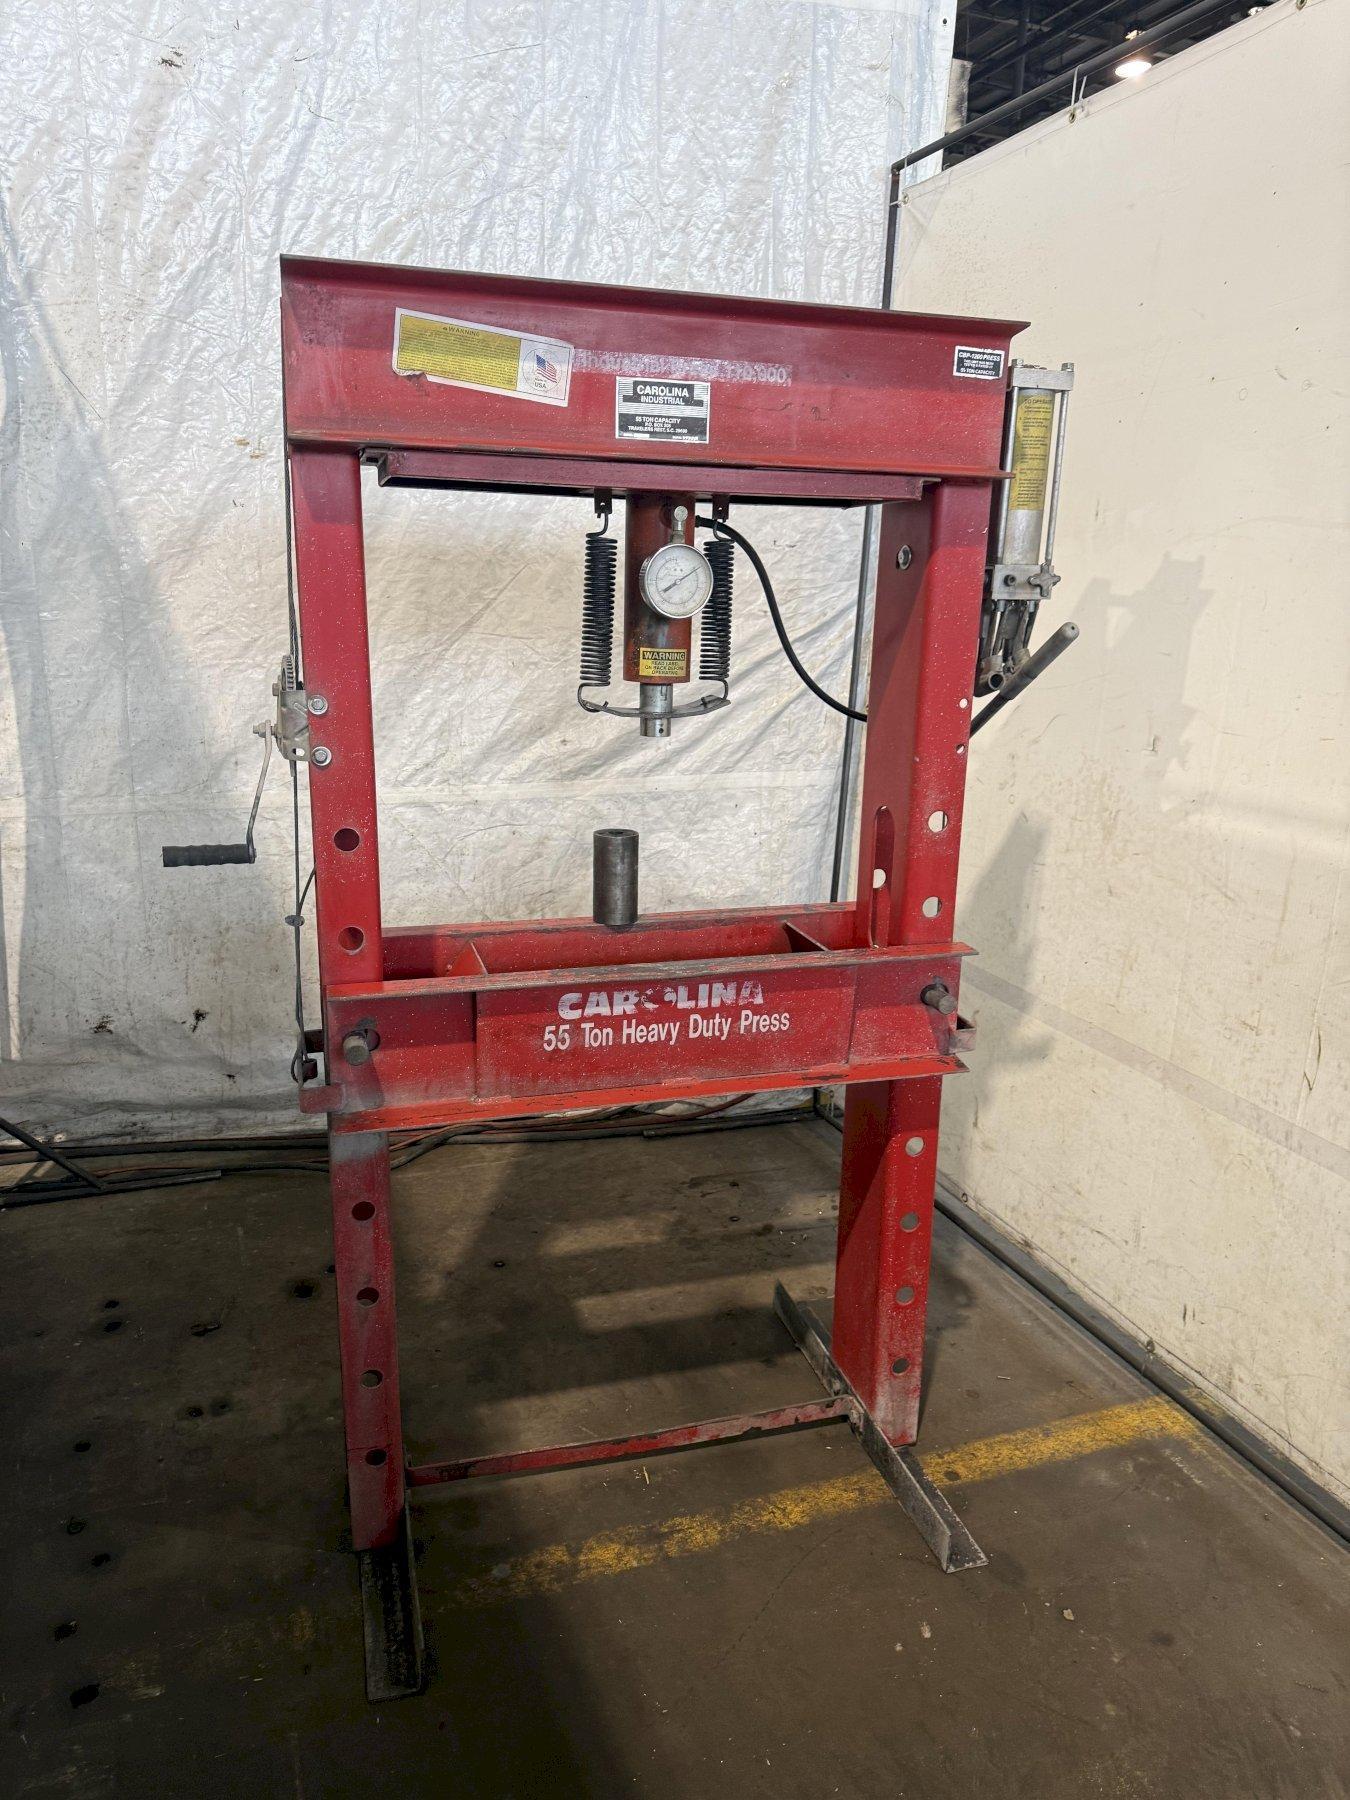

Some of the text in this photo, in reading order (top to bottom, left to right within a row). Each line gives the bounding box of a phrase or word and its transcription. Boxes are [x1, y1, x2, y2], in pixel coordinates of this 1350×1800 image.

[983, 354, 1001, 362] PRESS
[534, 381, 547, 389] USA
[636, 384, 690, 398] CAROLINA
[640, 396, 686, 405] INDUSTRIAL
[643, 651, 686, 660] WARNING
[543, 1009, 790, 1051] 55 Ton Heavy Duty Press
